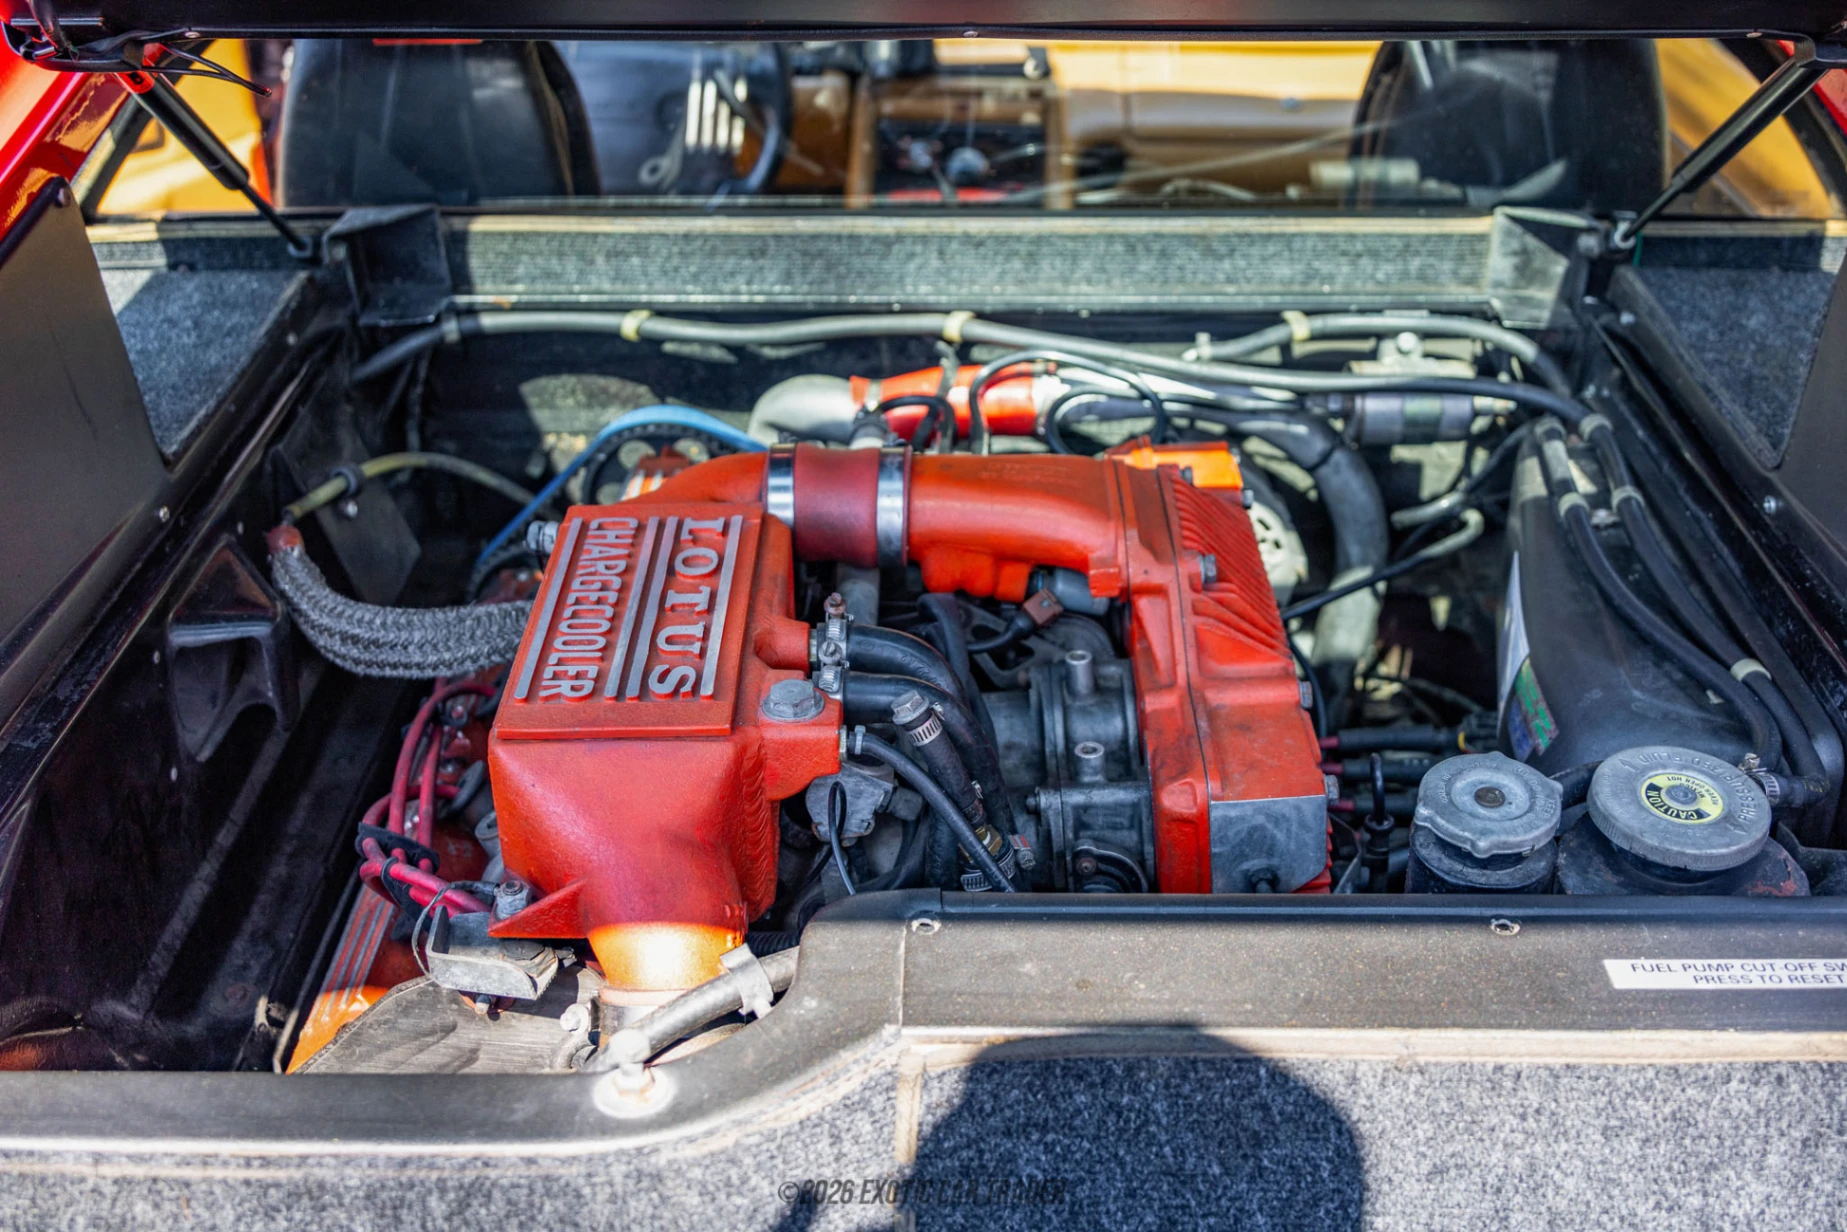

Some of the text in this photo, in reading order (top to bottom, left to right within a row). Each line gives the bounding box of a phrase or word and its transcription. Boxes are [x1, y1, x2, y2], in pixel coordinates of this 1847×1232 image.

[538, 516, 640, 699] CHARGECOOLER
[648, 516, 725, 698] LOTUS
[1638, 752, 1683, 765] FLUID
[1685, 778, 1705, 788] OPEN
[1647, 790, 1698, 820] CAUTION
[1630, 962, 1679, 973] FUEL
[1681, 962, 1734, 973] PUMP
[1693, 974, 1844, 984] PRESS TO RESET
